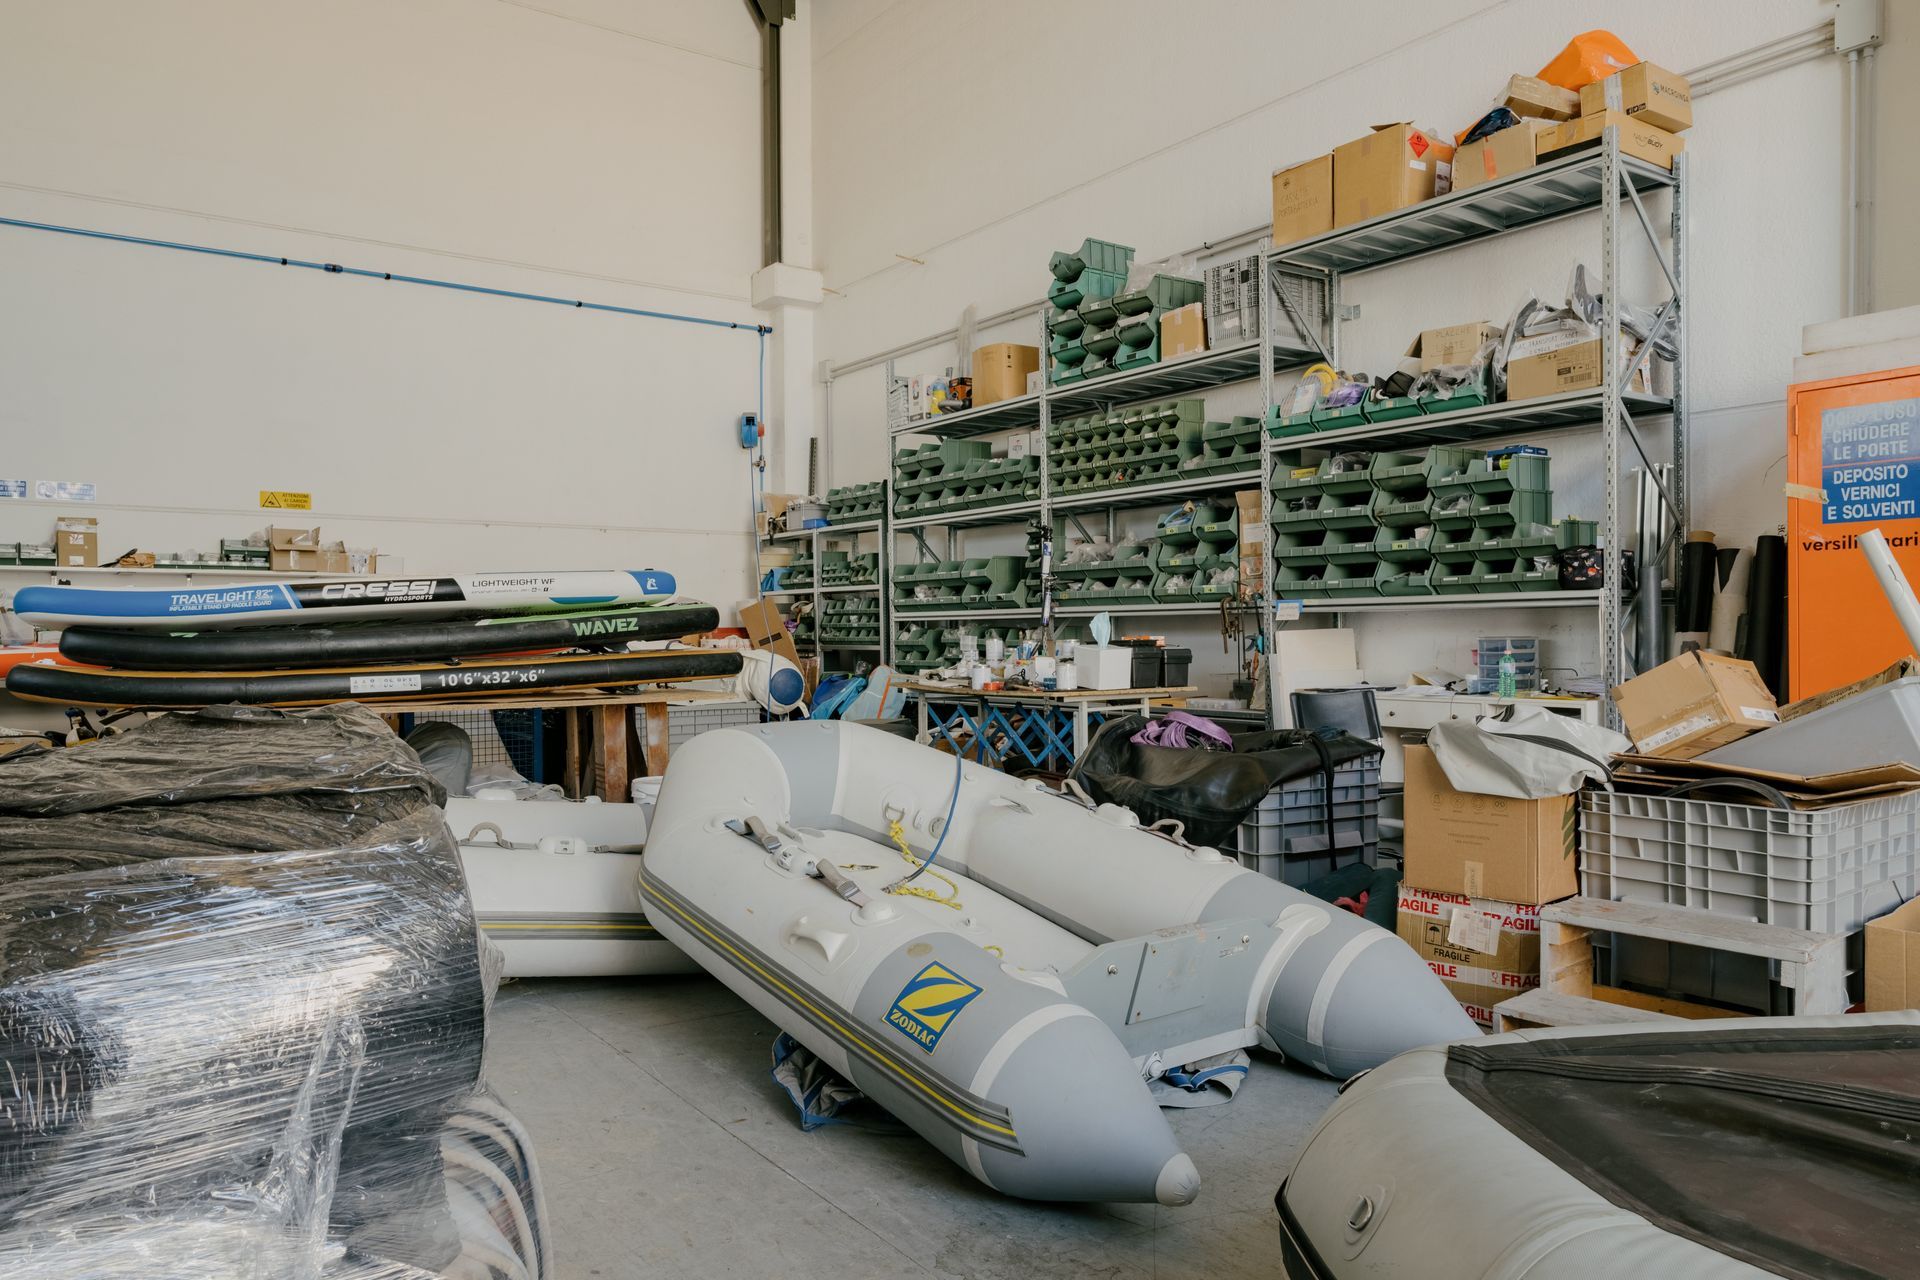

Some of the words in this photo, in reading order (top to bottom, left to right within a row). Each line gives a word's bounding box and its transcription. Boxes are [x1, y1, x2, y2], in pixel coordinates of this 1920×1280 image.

[1832, 422, 1910, 444] CHIUDERE
[1833, 445, 1852, 461] LE
[1857, 440, 1909, 458] PORTE
[1833, 464, 1909, 485] DEPOSITO
[1841, 483, 1900, 502] VERNICI
[1827, 506, 1838, 520] E
[1843, 500, 1915, 519] SOLVENTI
[321, 580, 437, 599] CRESSI
[472, 578, 539, 588] LIGHTWEIGHT
[171, 590, 255, 605] TRAVELIGHT
[384, 594, 433, 602] HYDROSPORTS
[572, 617, 639, 637] WAVEZ
[1396, 898, 1440, 915] AGILE
[1433, 947, 1470, 963] FRAGILE
[1501, 973, 1540, 988] FRAG
[890, 1009, 936, 1047] ZODIAC
